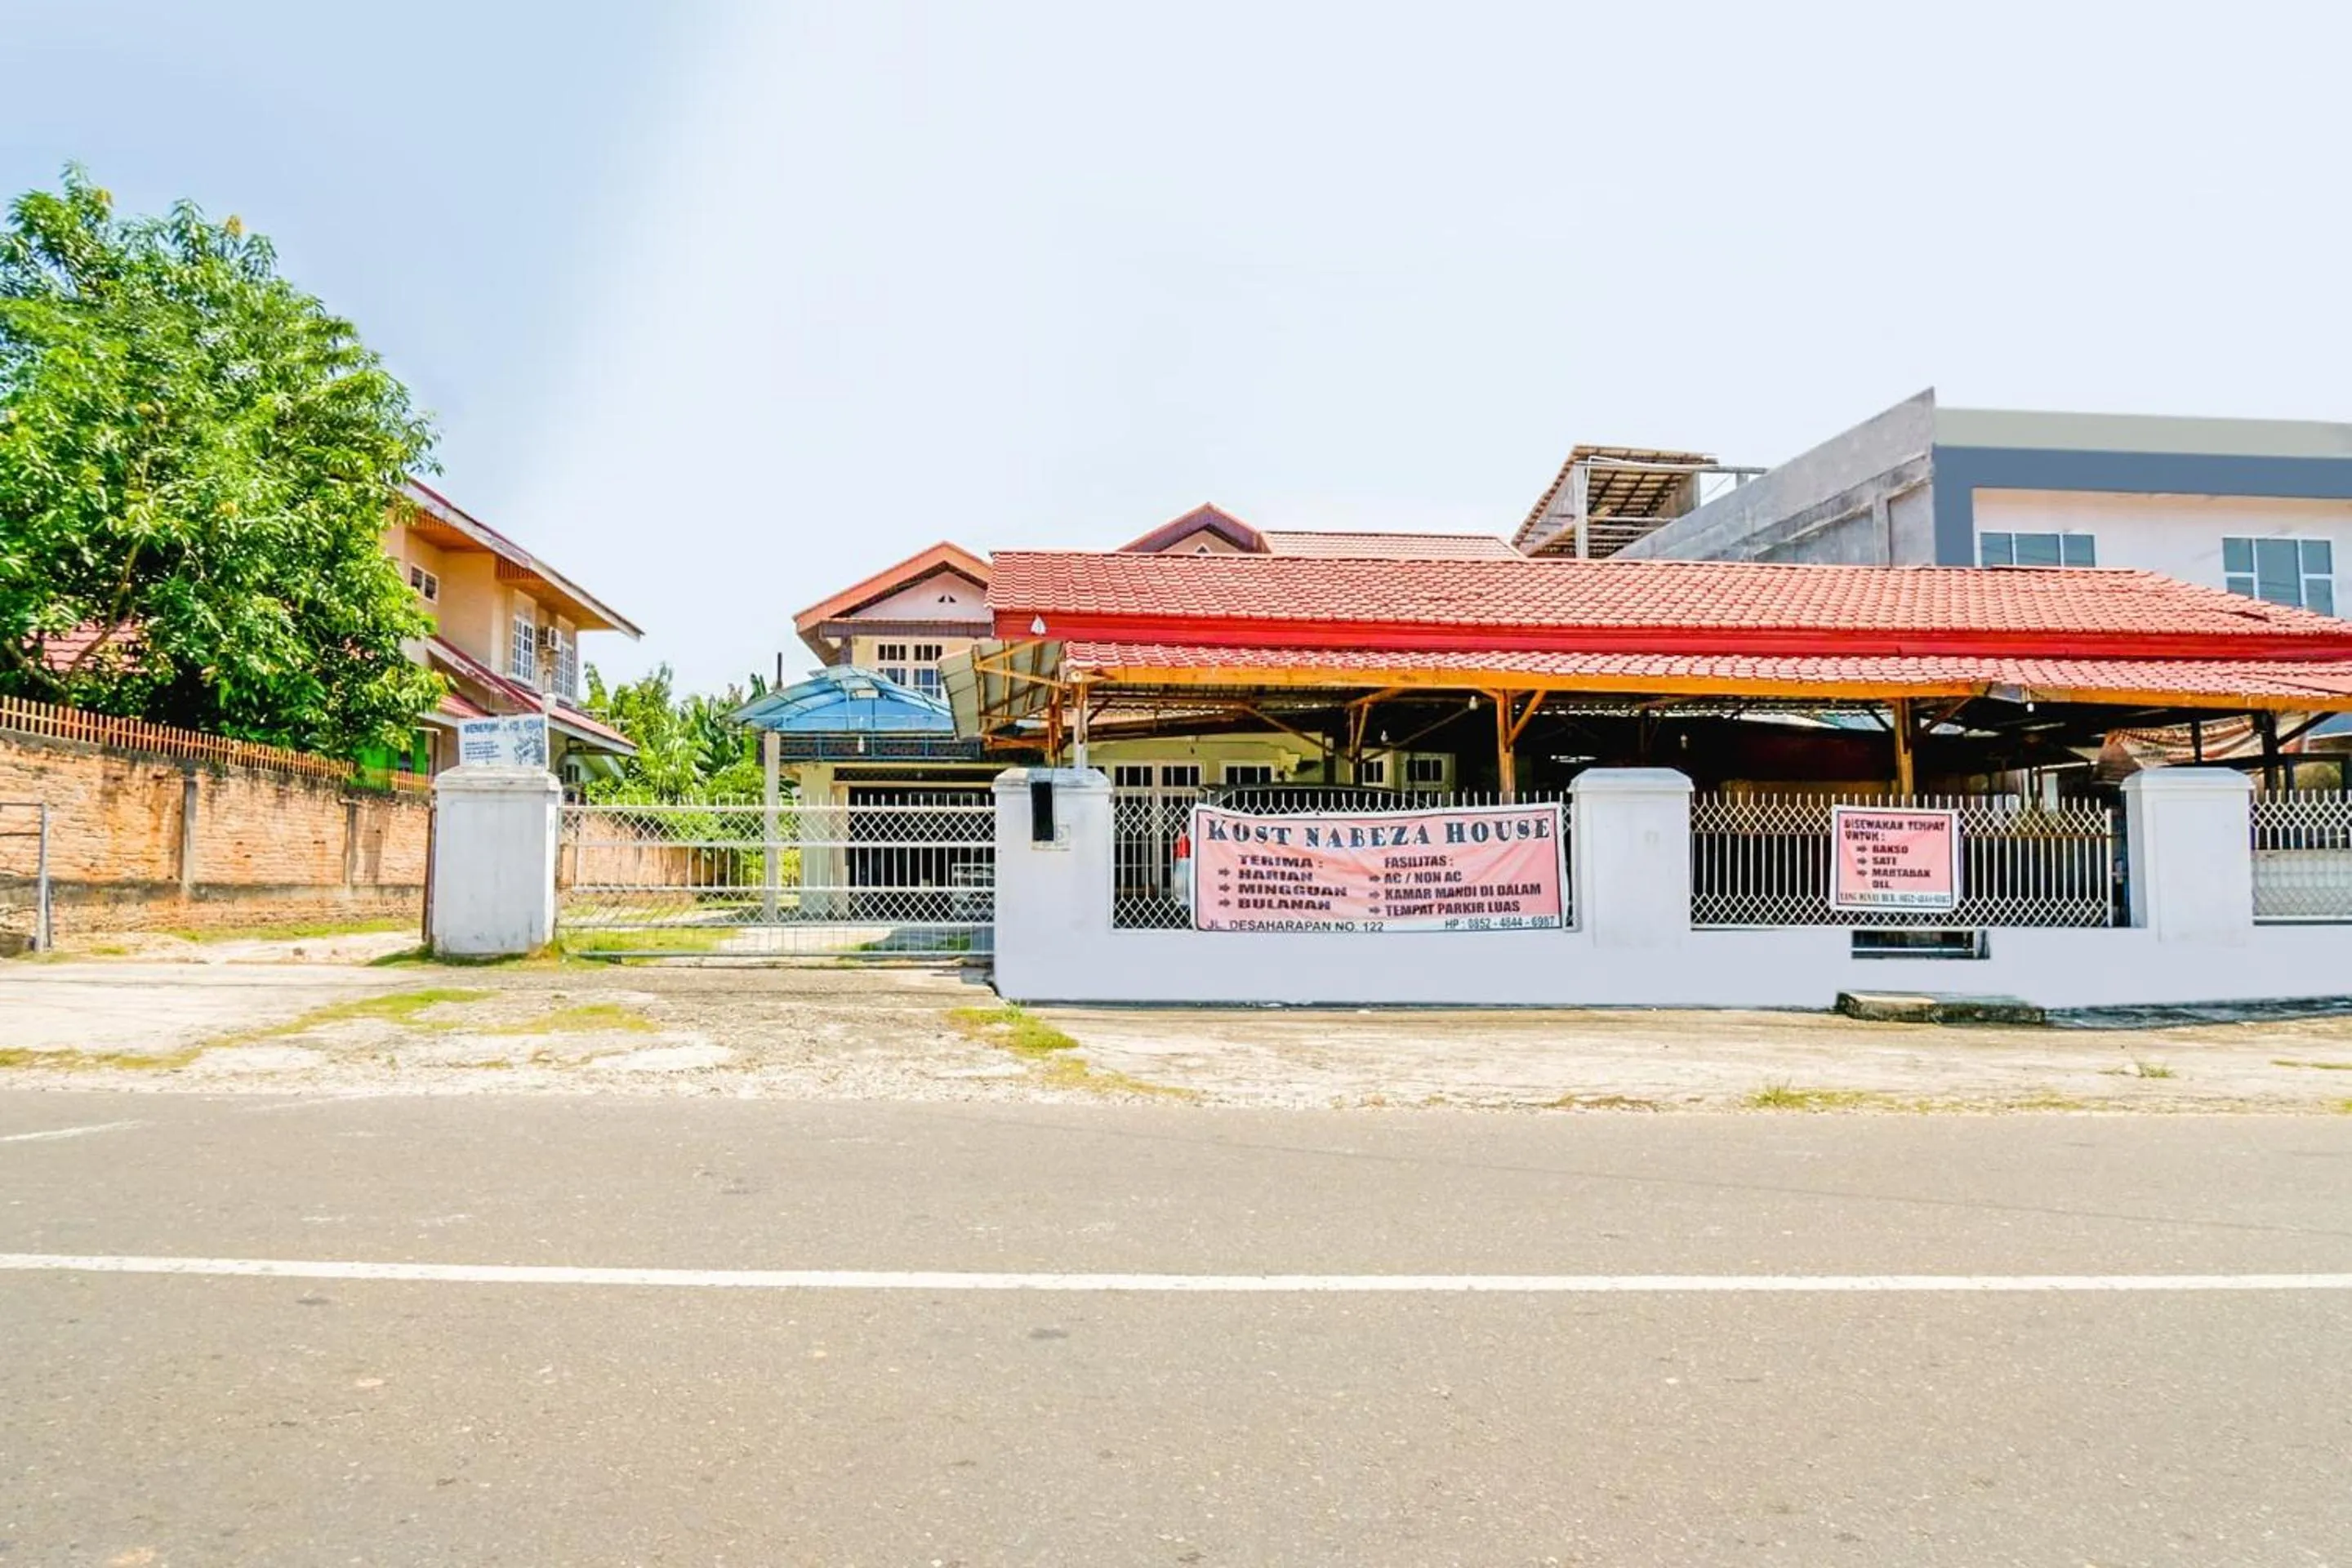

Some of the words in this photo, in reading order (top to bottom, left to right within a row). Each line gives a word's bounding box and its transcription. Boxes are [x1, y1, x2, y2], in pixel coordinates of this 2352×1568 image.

[1207, 818, 1291, 846] KOST
[1304, 824, 1430, 848] NABEZA
[1446, 817, 1550, 844] HOUSE
[1238, 854, 1313, 868] TERIMA
[1385, 855, 1447, 868] FASILITAS
[1238, 869, 1313, 881] HARIAN
[1384, 873, 1402, 884] AC
[1414, 872, 1442, 883] NON
[1444, 871, 1462, 882] AC
[1238, 884, 1347, 897] MINGGUAN
[1385, 888, 1432, 901] KAMAR
[1435, 885, 1477, 898] MANDI
[1480, 884, 1494, 896] DI
[1497, 884, 1541, 896] DALAM
[1238, 898, 1331, 910] BULANAN
[1385, 904, 1434, 916] TEMPAT
[1437, 902, 1485, 915] PARKIR
[1488, 901, 1520, 912] LUAS
[1229, 920, 1331, 932] DESAHARAPAN
[1363, 921, 1383, 932] 122
[1445, 919, 1459, 929] HP
